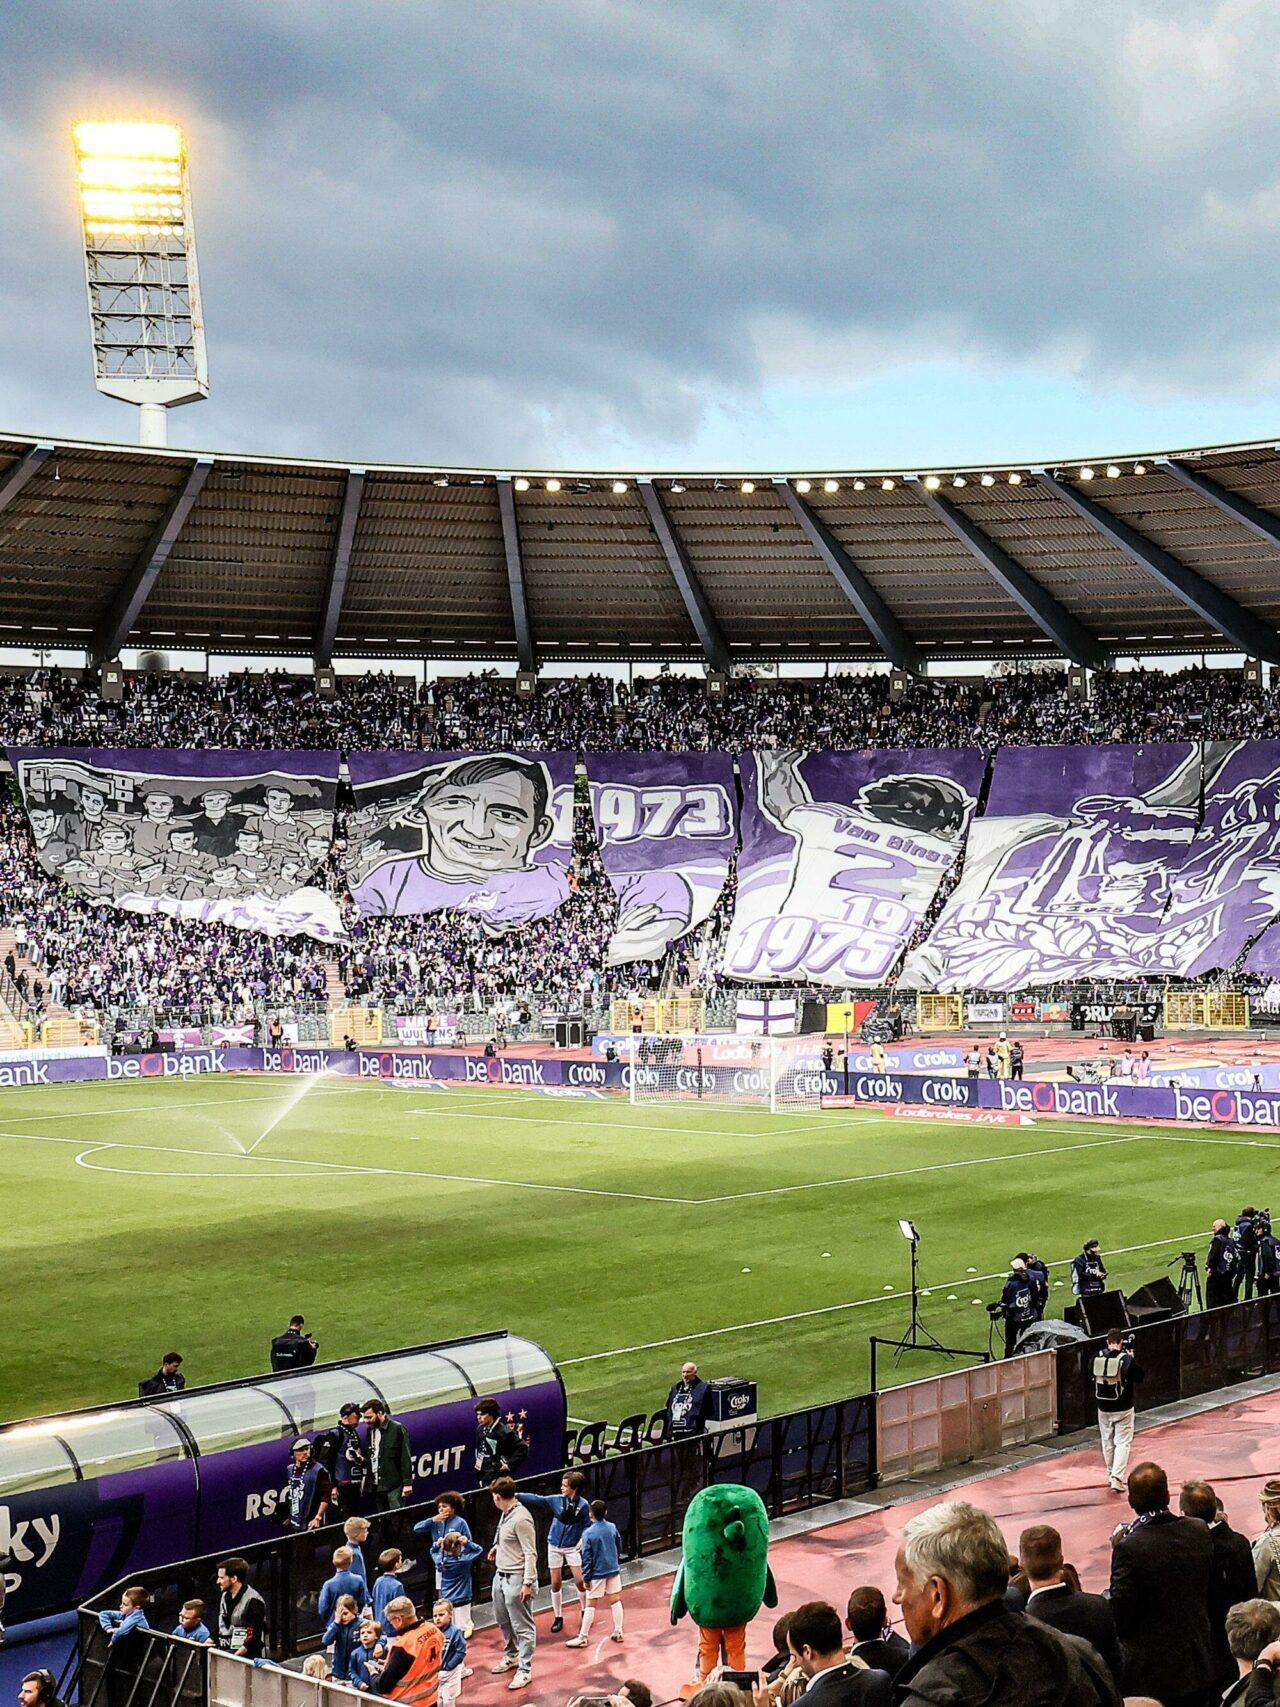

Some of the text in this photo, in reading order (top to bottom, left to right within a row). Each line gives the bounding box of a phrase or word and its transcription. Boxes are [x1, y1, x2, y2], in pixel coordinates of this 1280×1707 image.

[834, 818, 953, 866] Van Binst
[729, 916, 900, 980] 1975
[913, 1050, 957, 1068] Croky
[568, 1063, 606, 1085] Croky
[857, 1075, 902, 1099] Croky
[922, 1079, 969, 1104] Croky
